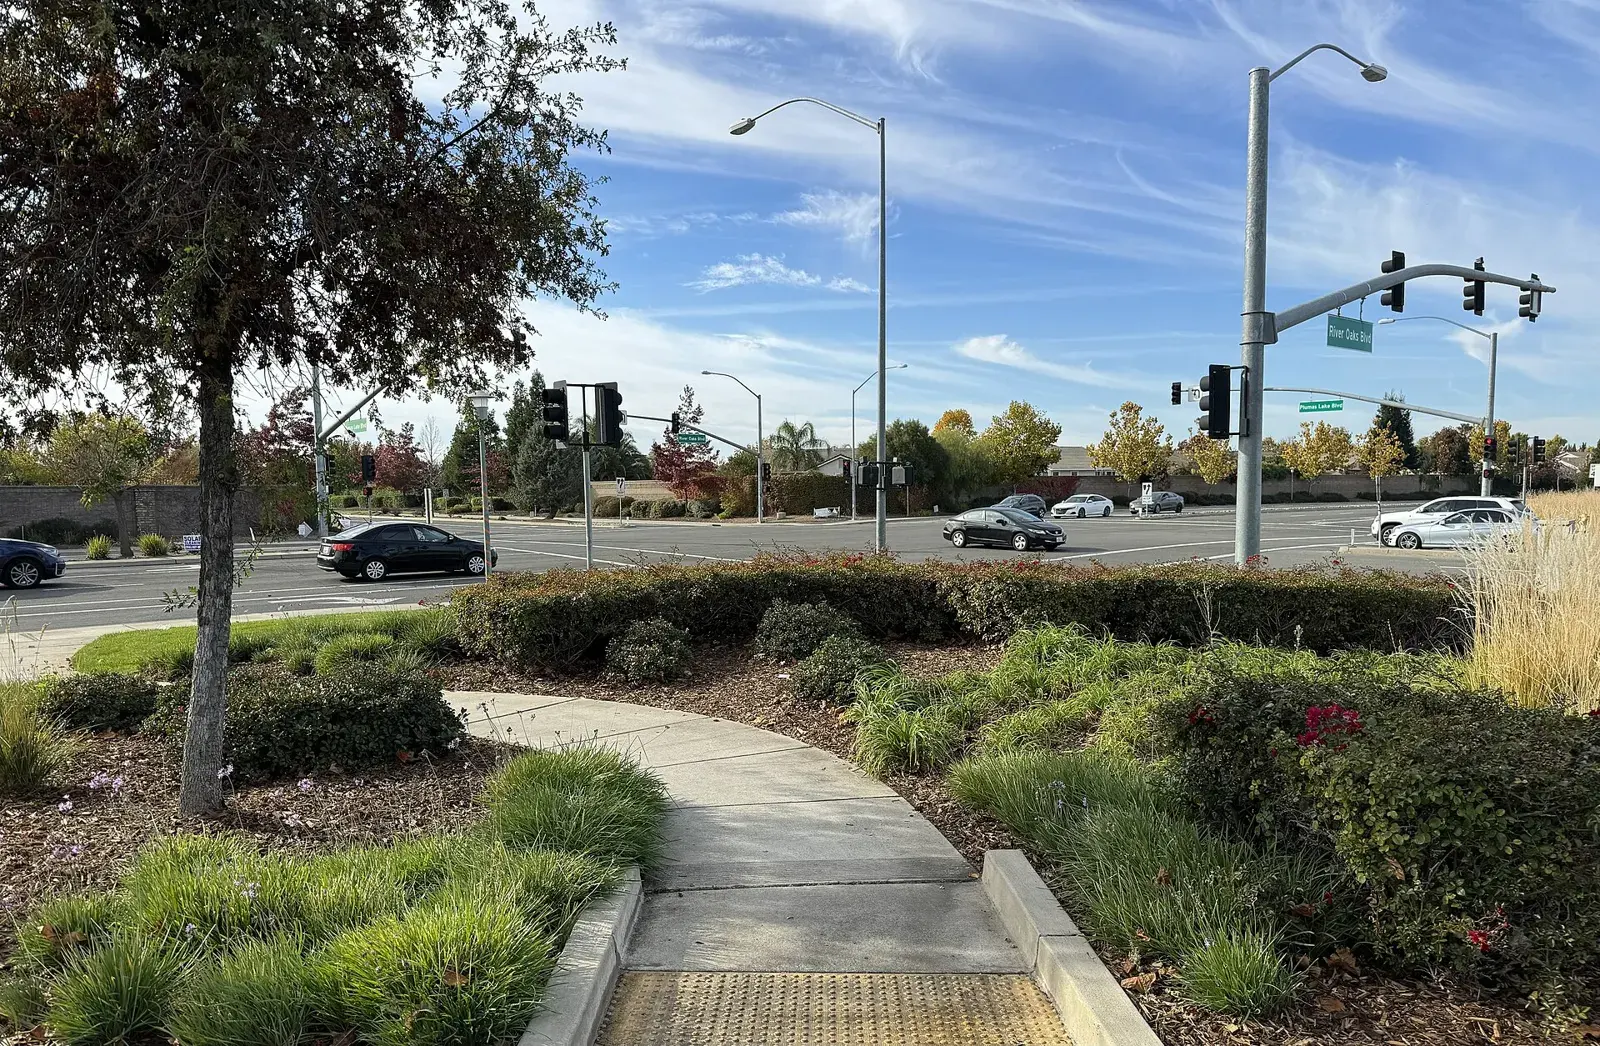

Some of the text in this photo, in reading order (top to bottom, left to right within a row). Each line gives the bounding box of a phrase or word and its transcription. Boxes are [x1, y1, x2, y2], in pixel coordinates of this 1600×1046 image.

[1329, 325, 1371, 343] River Oaks Blvd
